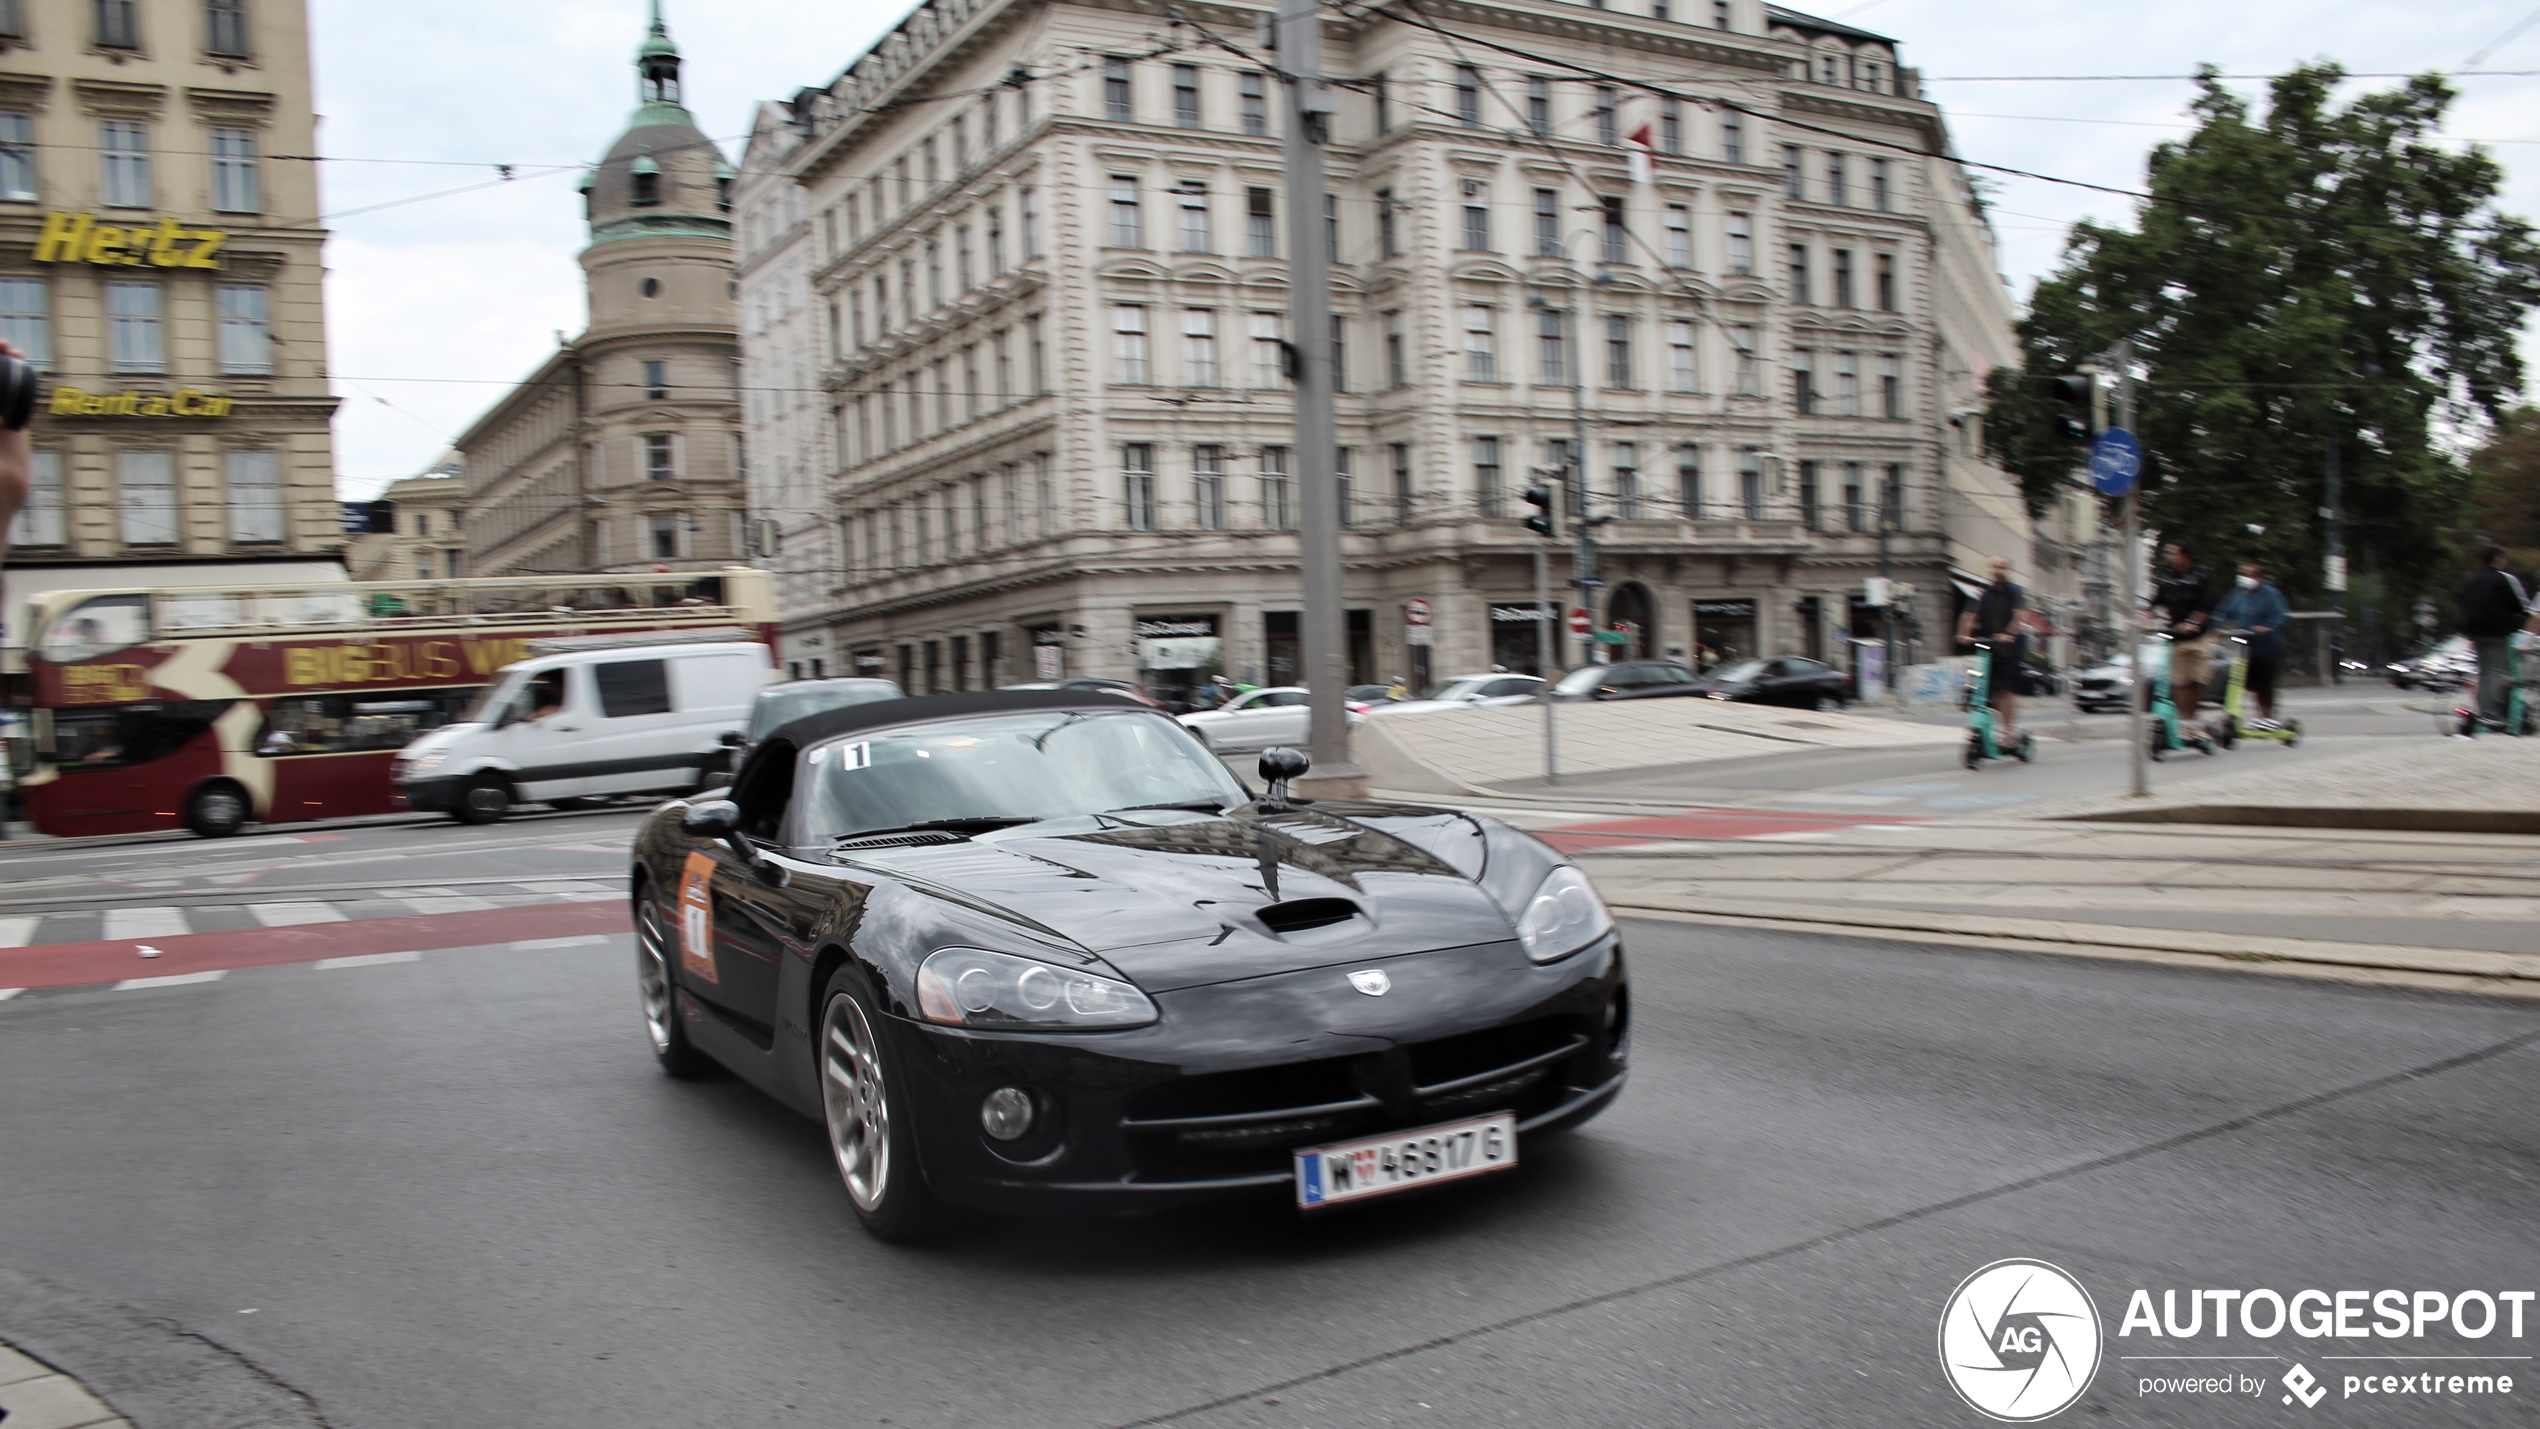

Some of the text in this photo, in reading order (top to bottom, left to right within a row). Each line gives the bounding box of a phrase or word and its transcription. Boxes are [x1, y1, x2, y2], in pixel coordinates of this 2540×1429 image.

[33, 211, 228, 268] Hertz
[50, 386, 234, 416] Rent a Car
[850, 744, 864, 767] 1
[1326, 1154, 1353, 1192] W
[1379, 1130, 1477, 1182] 46817
